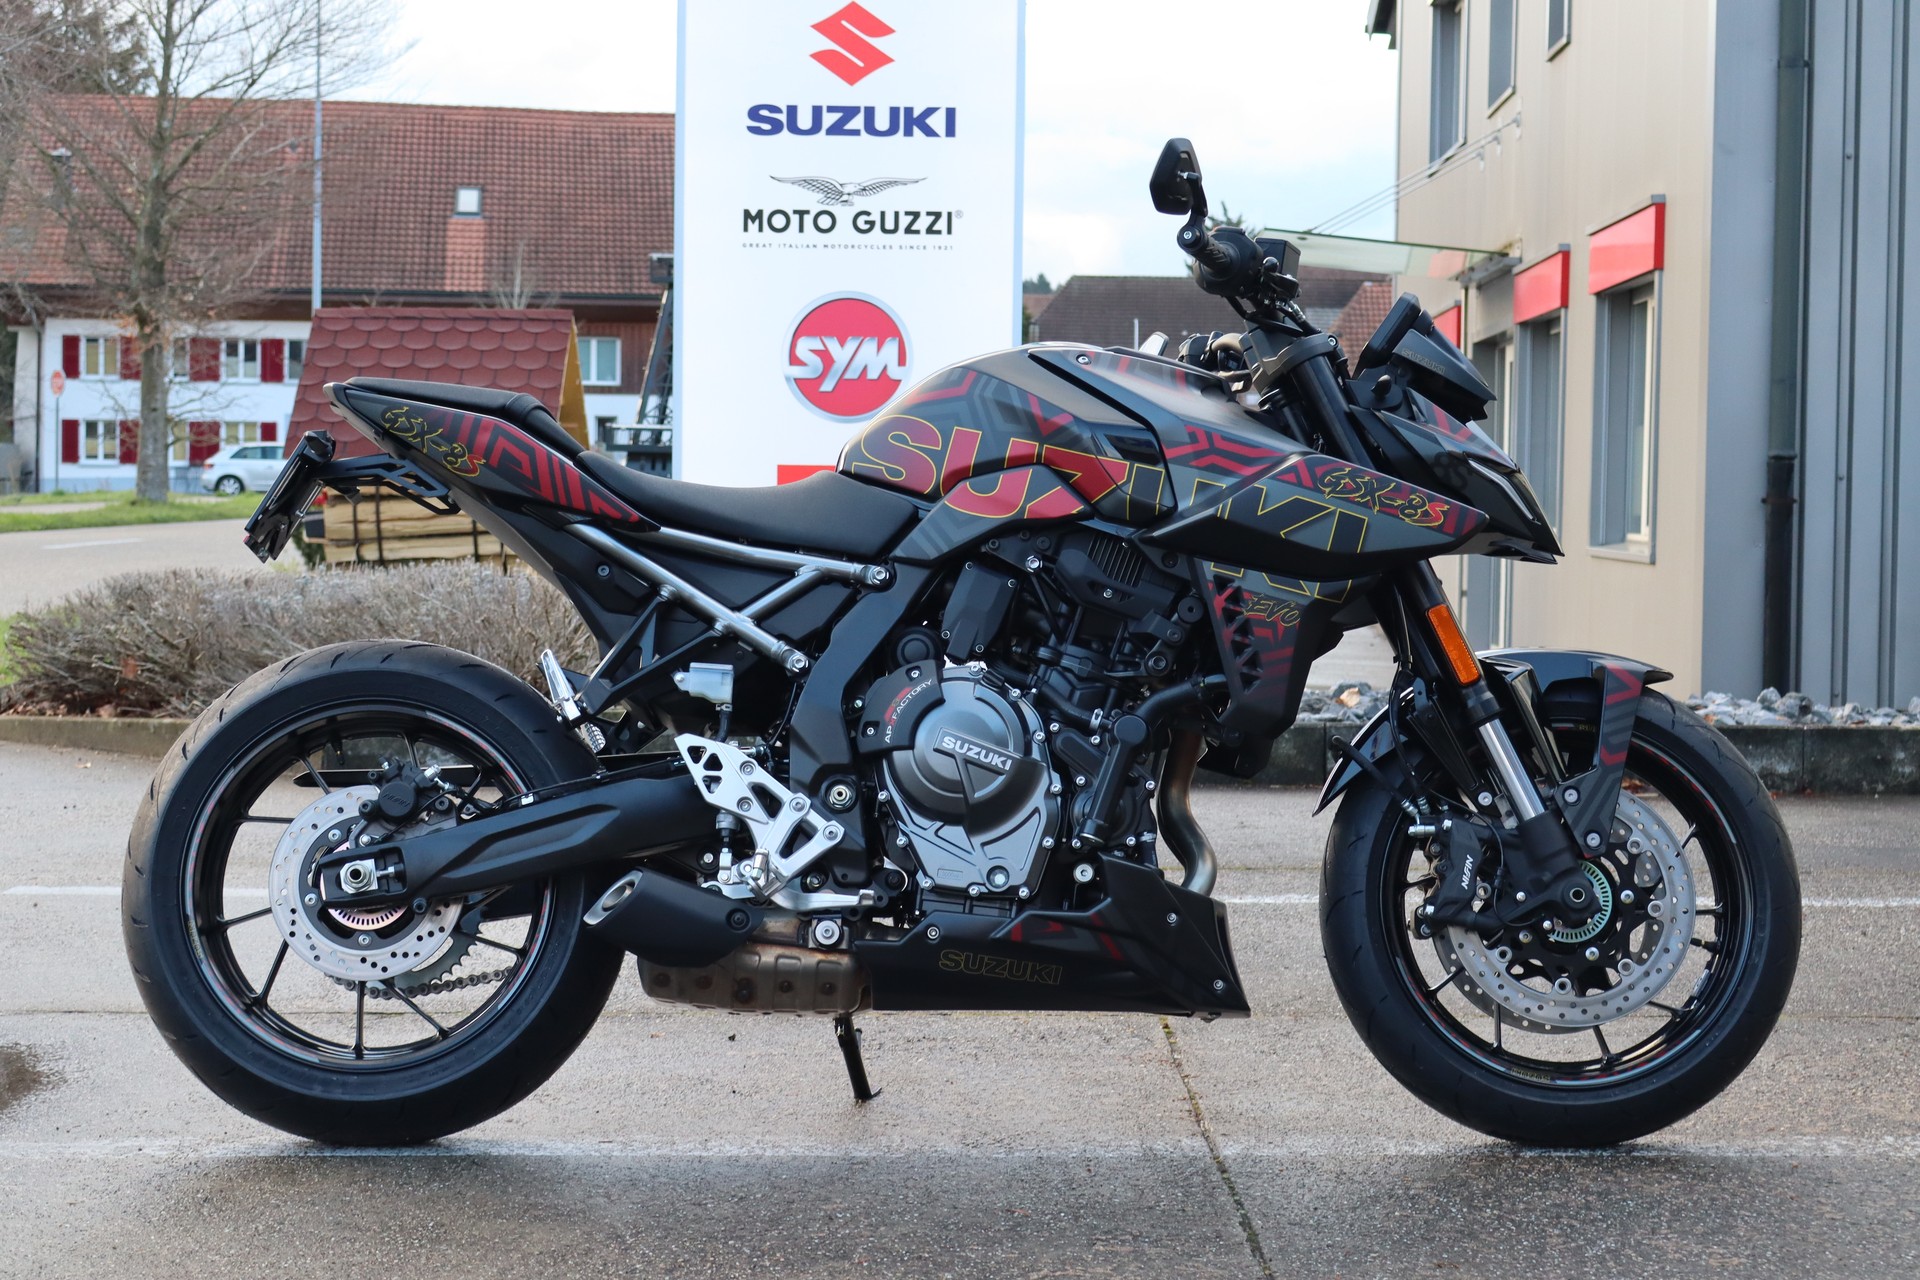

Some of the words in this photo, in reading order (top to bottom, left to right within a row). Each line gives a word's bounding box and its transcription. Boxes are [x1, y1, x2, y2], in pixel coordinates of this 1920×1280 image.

[746, 103, 957, 138] SUZUKI
[743, 208, 837, 234] MOTO
[852, 210, 953, 235] GUZZI
[785, 335, 907, 392] SYM
[1402, 347, 1446, 375] SUZUKI
[380, 406, 487, 477] GSX-8S
[1317, 467, 1450, 526] GSX-8S
[1242, 593, 1301, 627] EVO
[941, 736, 1013, 771] SUZUKI
[938, 949, 1063, 985] SUZUKI
